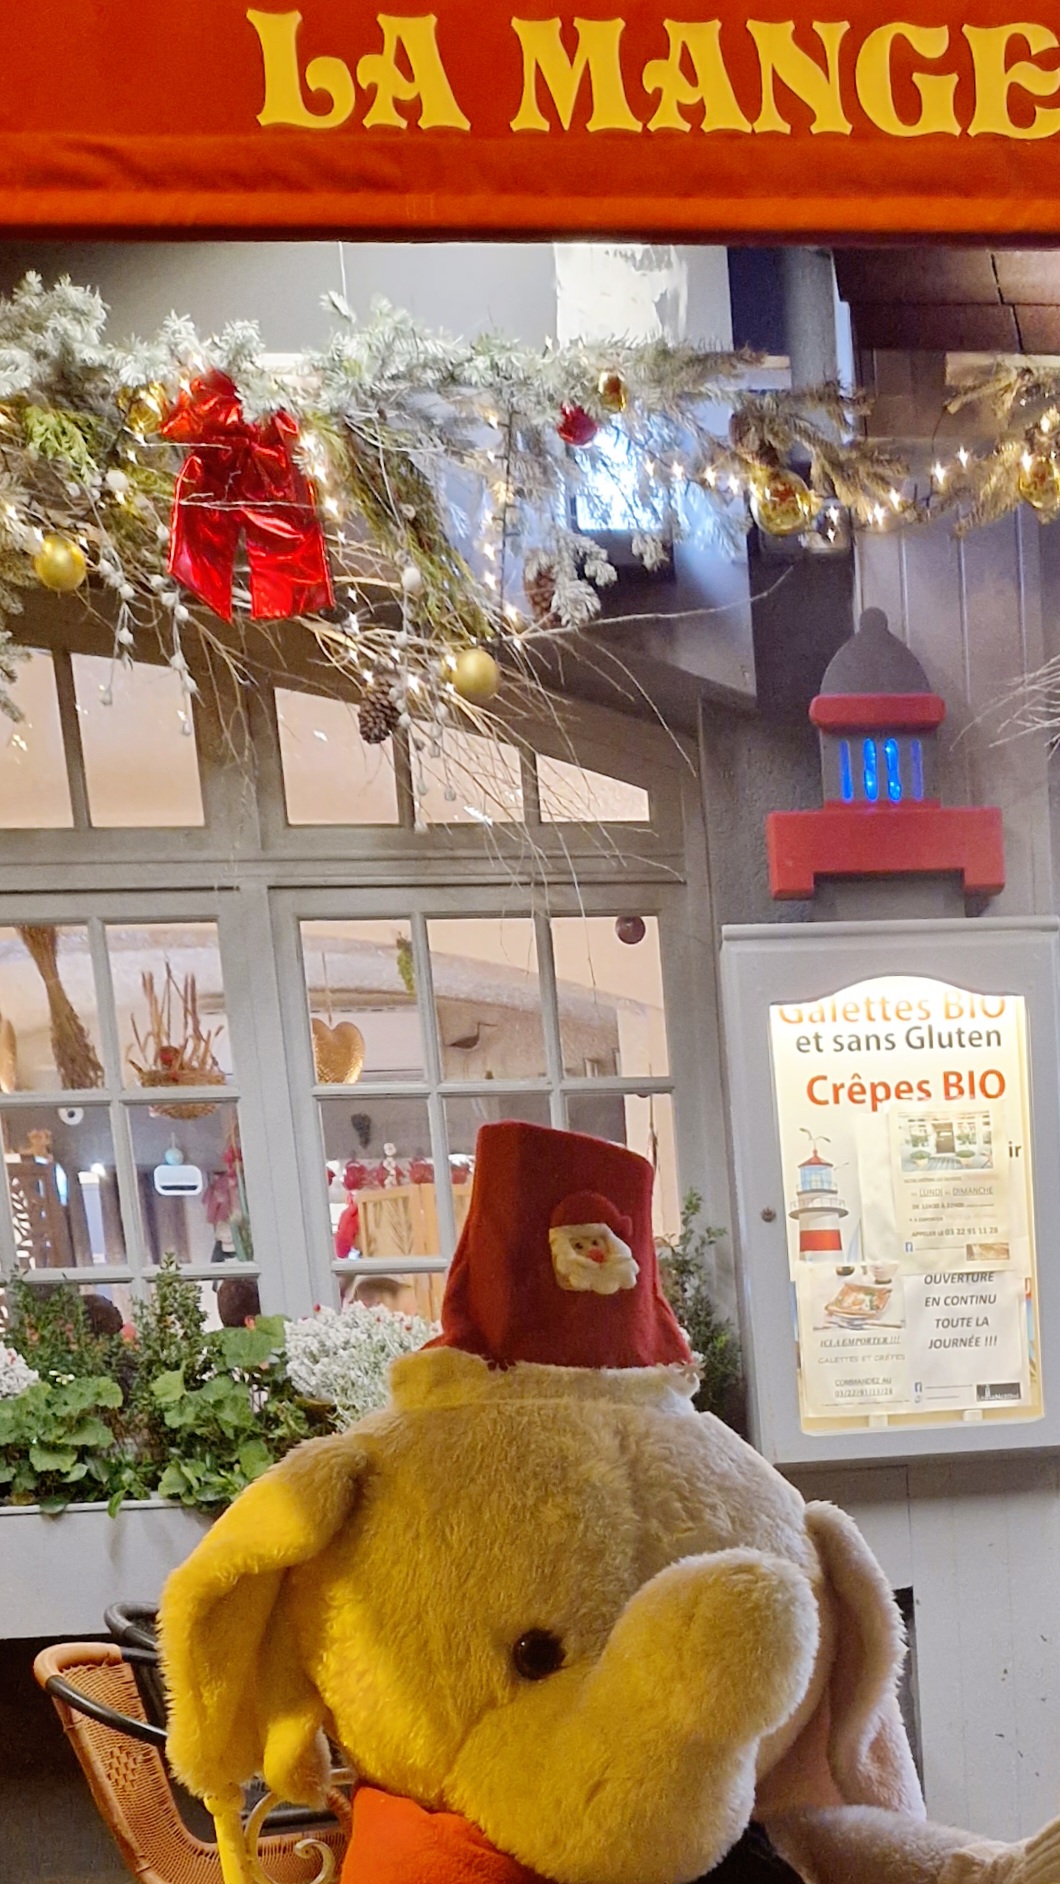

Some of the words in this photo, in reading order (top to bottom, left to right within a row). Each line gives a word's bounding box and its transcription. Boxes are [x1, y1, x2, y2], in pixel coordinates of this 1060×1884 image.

[246, 8, 471, 132] LA
[778, 996, 931, 1024] Galettes
[944, 993, 1007, 1021] BIO
[796, 1031, 824, 1053] et
[832, 1032, 897, 1053] sans
[904, 1024, 1002, 1051] Gluten
[806, 1072, 932, 1112] Crêpes
[942, 1069, 1006, 1101] BIO
[924, 1272, 994, 1286] OUVERTURE
[924, 1296, 942, 1308] EN
[943, 1294, 998, 1307] CONTINU
[934, 1316, 974, 1330] TOUTE
[975, 1316, 990, 1328] LA
[927, 1334, 982, 1351] JOURNÉE
